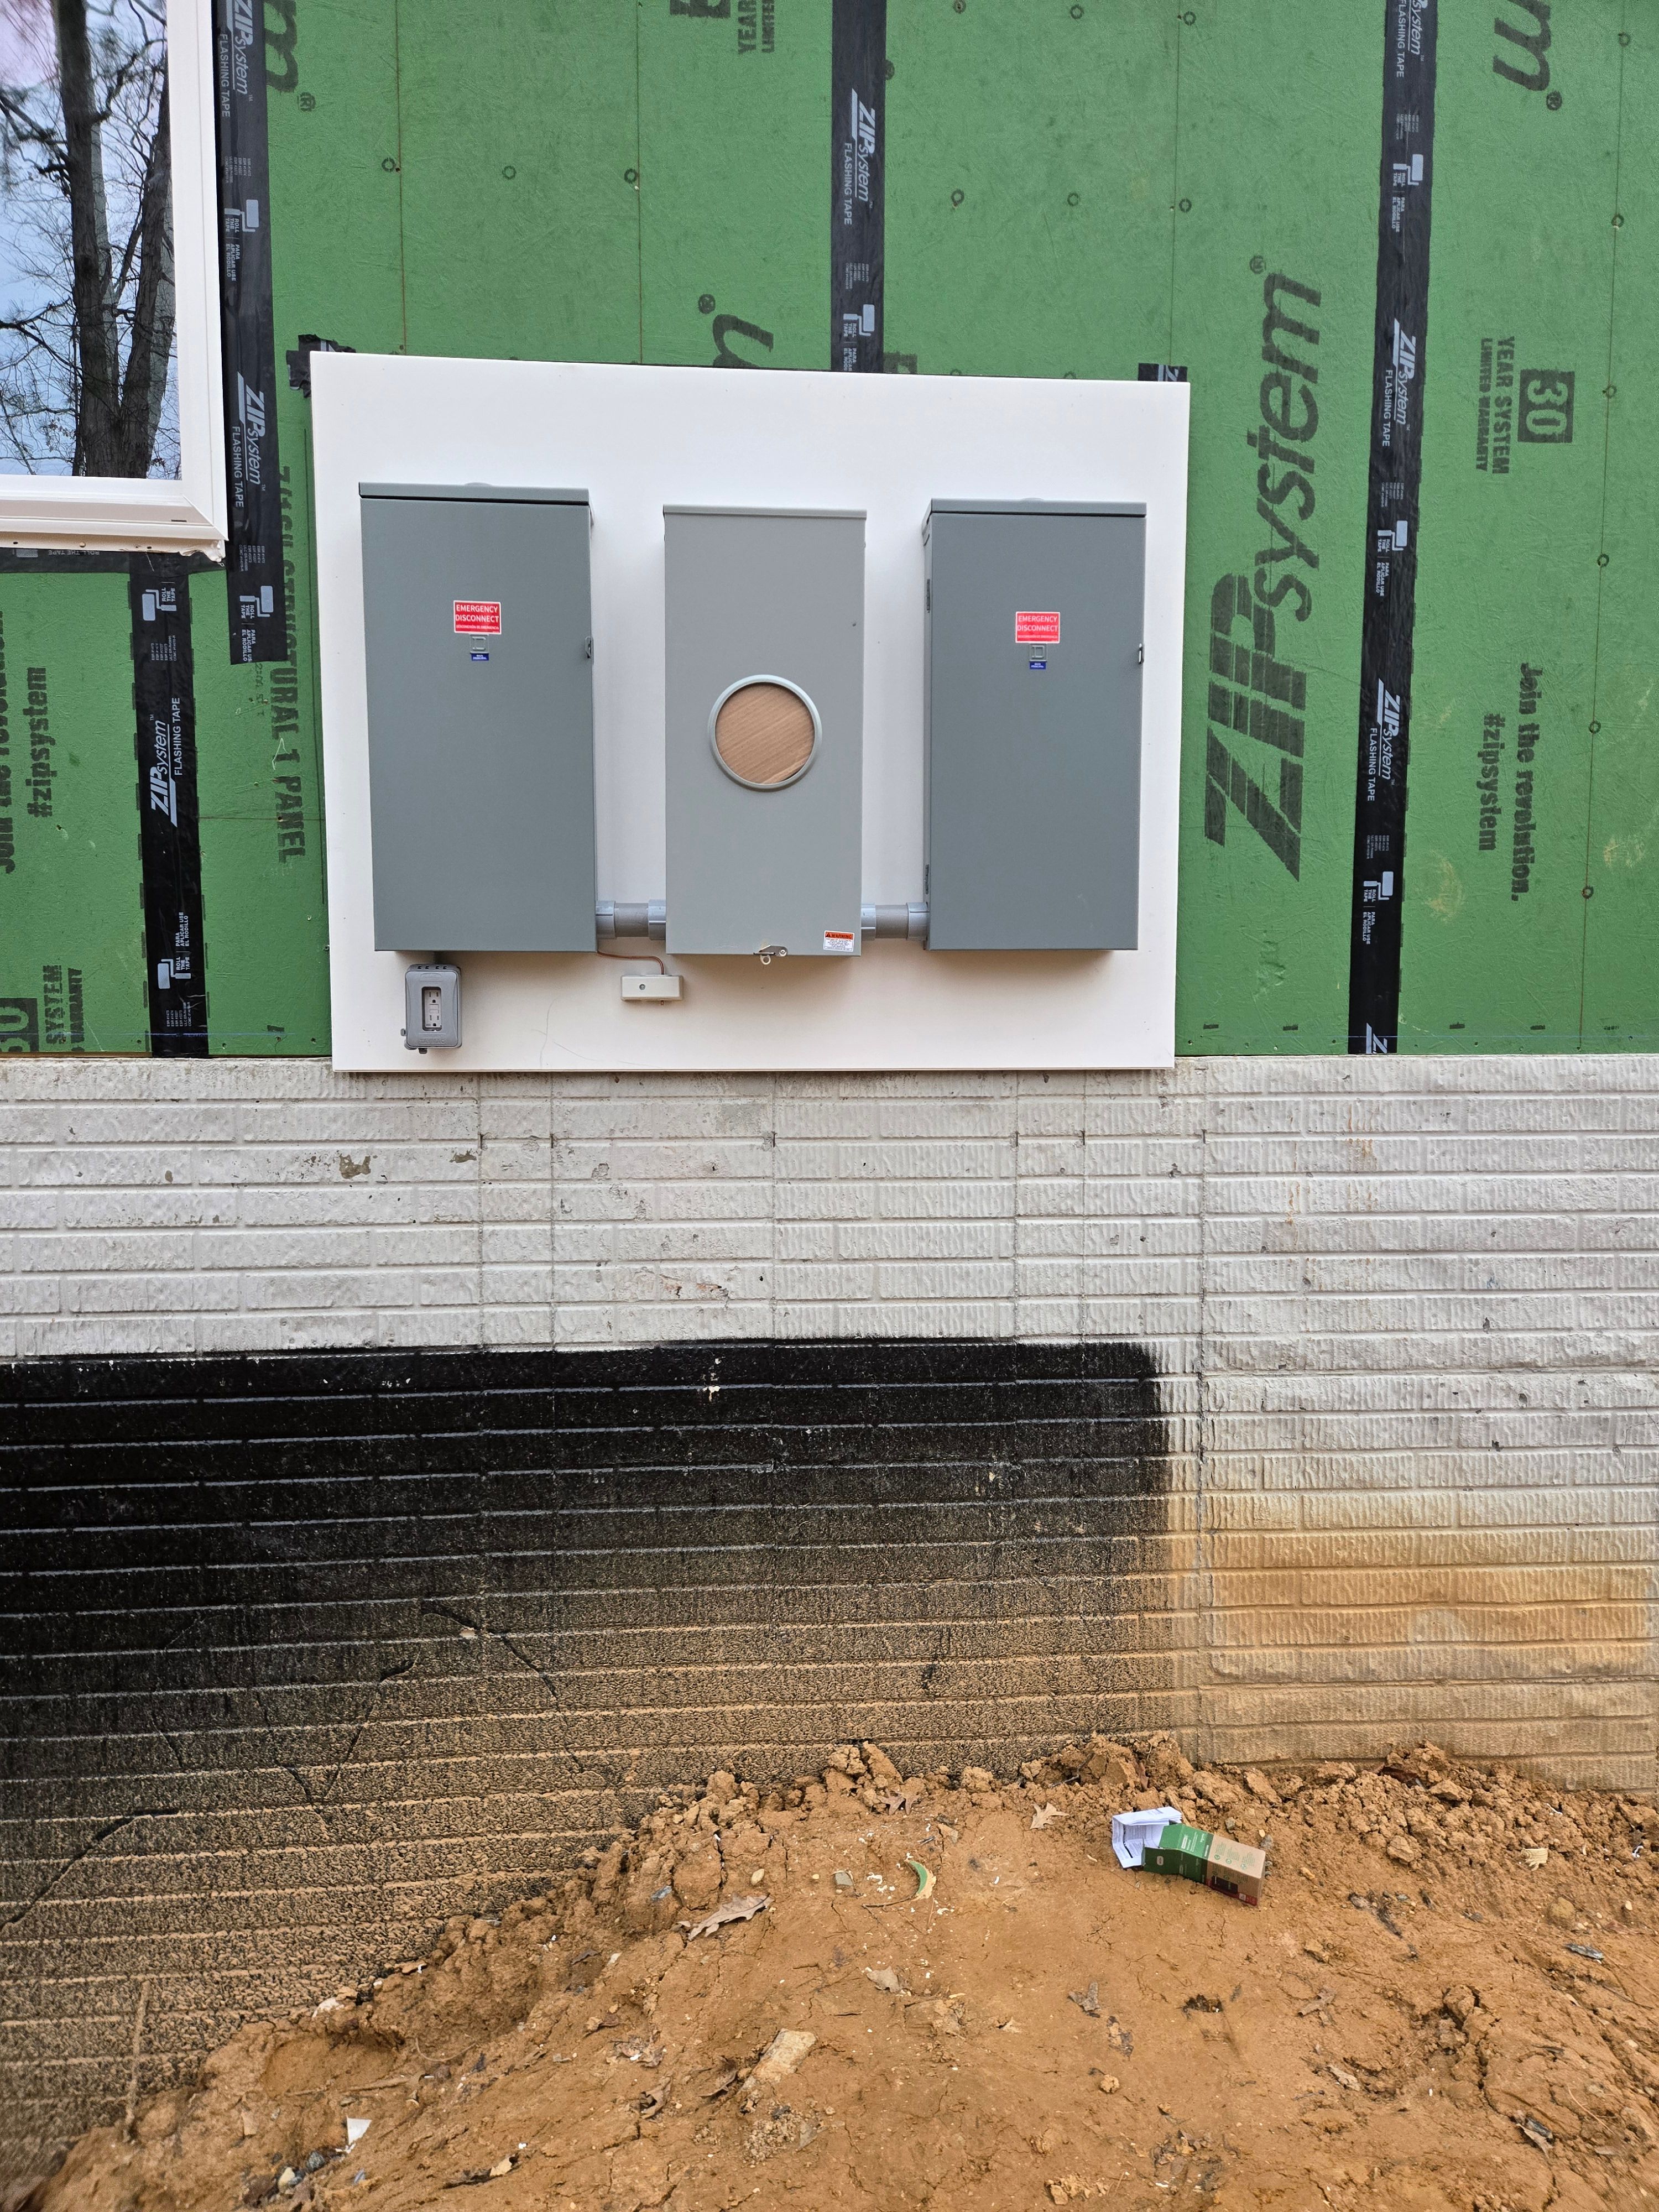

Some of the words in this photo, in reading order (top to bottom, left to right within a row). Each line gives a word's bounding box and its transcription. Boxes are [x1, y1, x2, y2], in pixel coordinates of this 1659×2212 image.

[738, 0, 757, 55] YEAR
[220, 34, 230, 87] FLASHING
[1396, 52, 1405, 77] TAPE
[222, 90, 230, 117] TAPE
[1479, 338, 1492, 393] LIMITED
[1496, 336, 1514, 388] YEAR
[1384, 370, 1392, 419] FLASHING
[1526, 379, 1568, 435] 30
[232, 426, 242, 478] FLASHING
[1493, 396, 1512, 474] SYSTEM
[234, 481, 243, 507] TAPE
[455, 614, 499, 623] DISCONNECT
[456, 604, 498, 613] EMERGENCY
[171, 698, 181, 723] TAPE
[1519, 663, 1542, 714] Join
[23, 667, 56, 818] #zipsystem
[173, 726, 182, 775] FLASHING
[1369, 728, 1377, 774] FLASHING
[1517, 724, 1540, 763] the
[1477, 714, 1505, 851] #zipsystem
[274, 776, 305, 864] PANEL
[1511, 770, 1536, 901] revolution.
[43, 965, 66, 1044] SYSTEM
